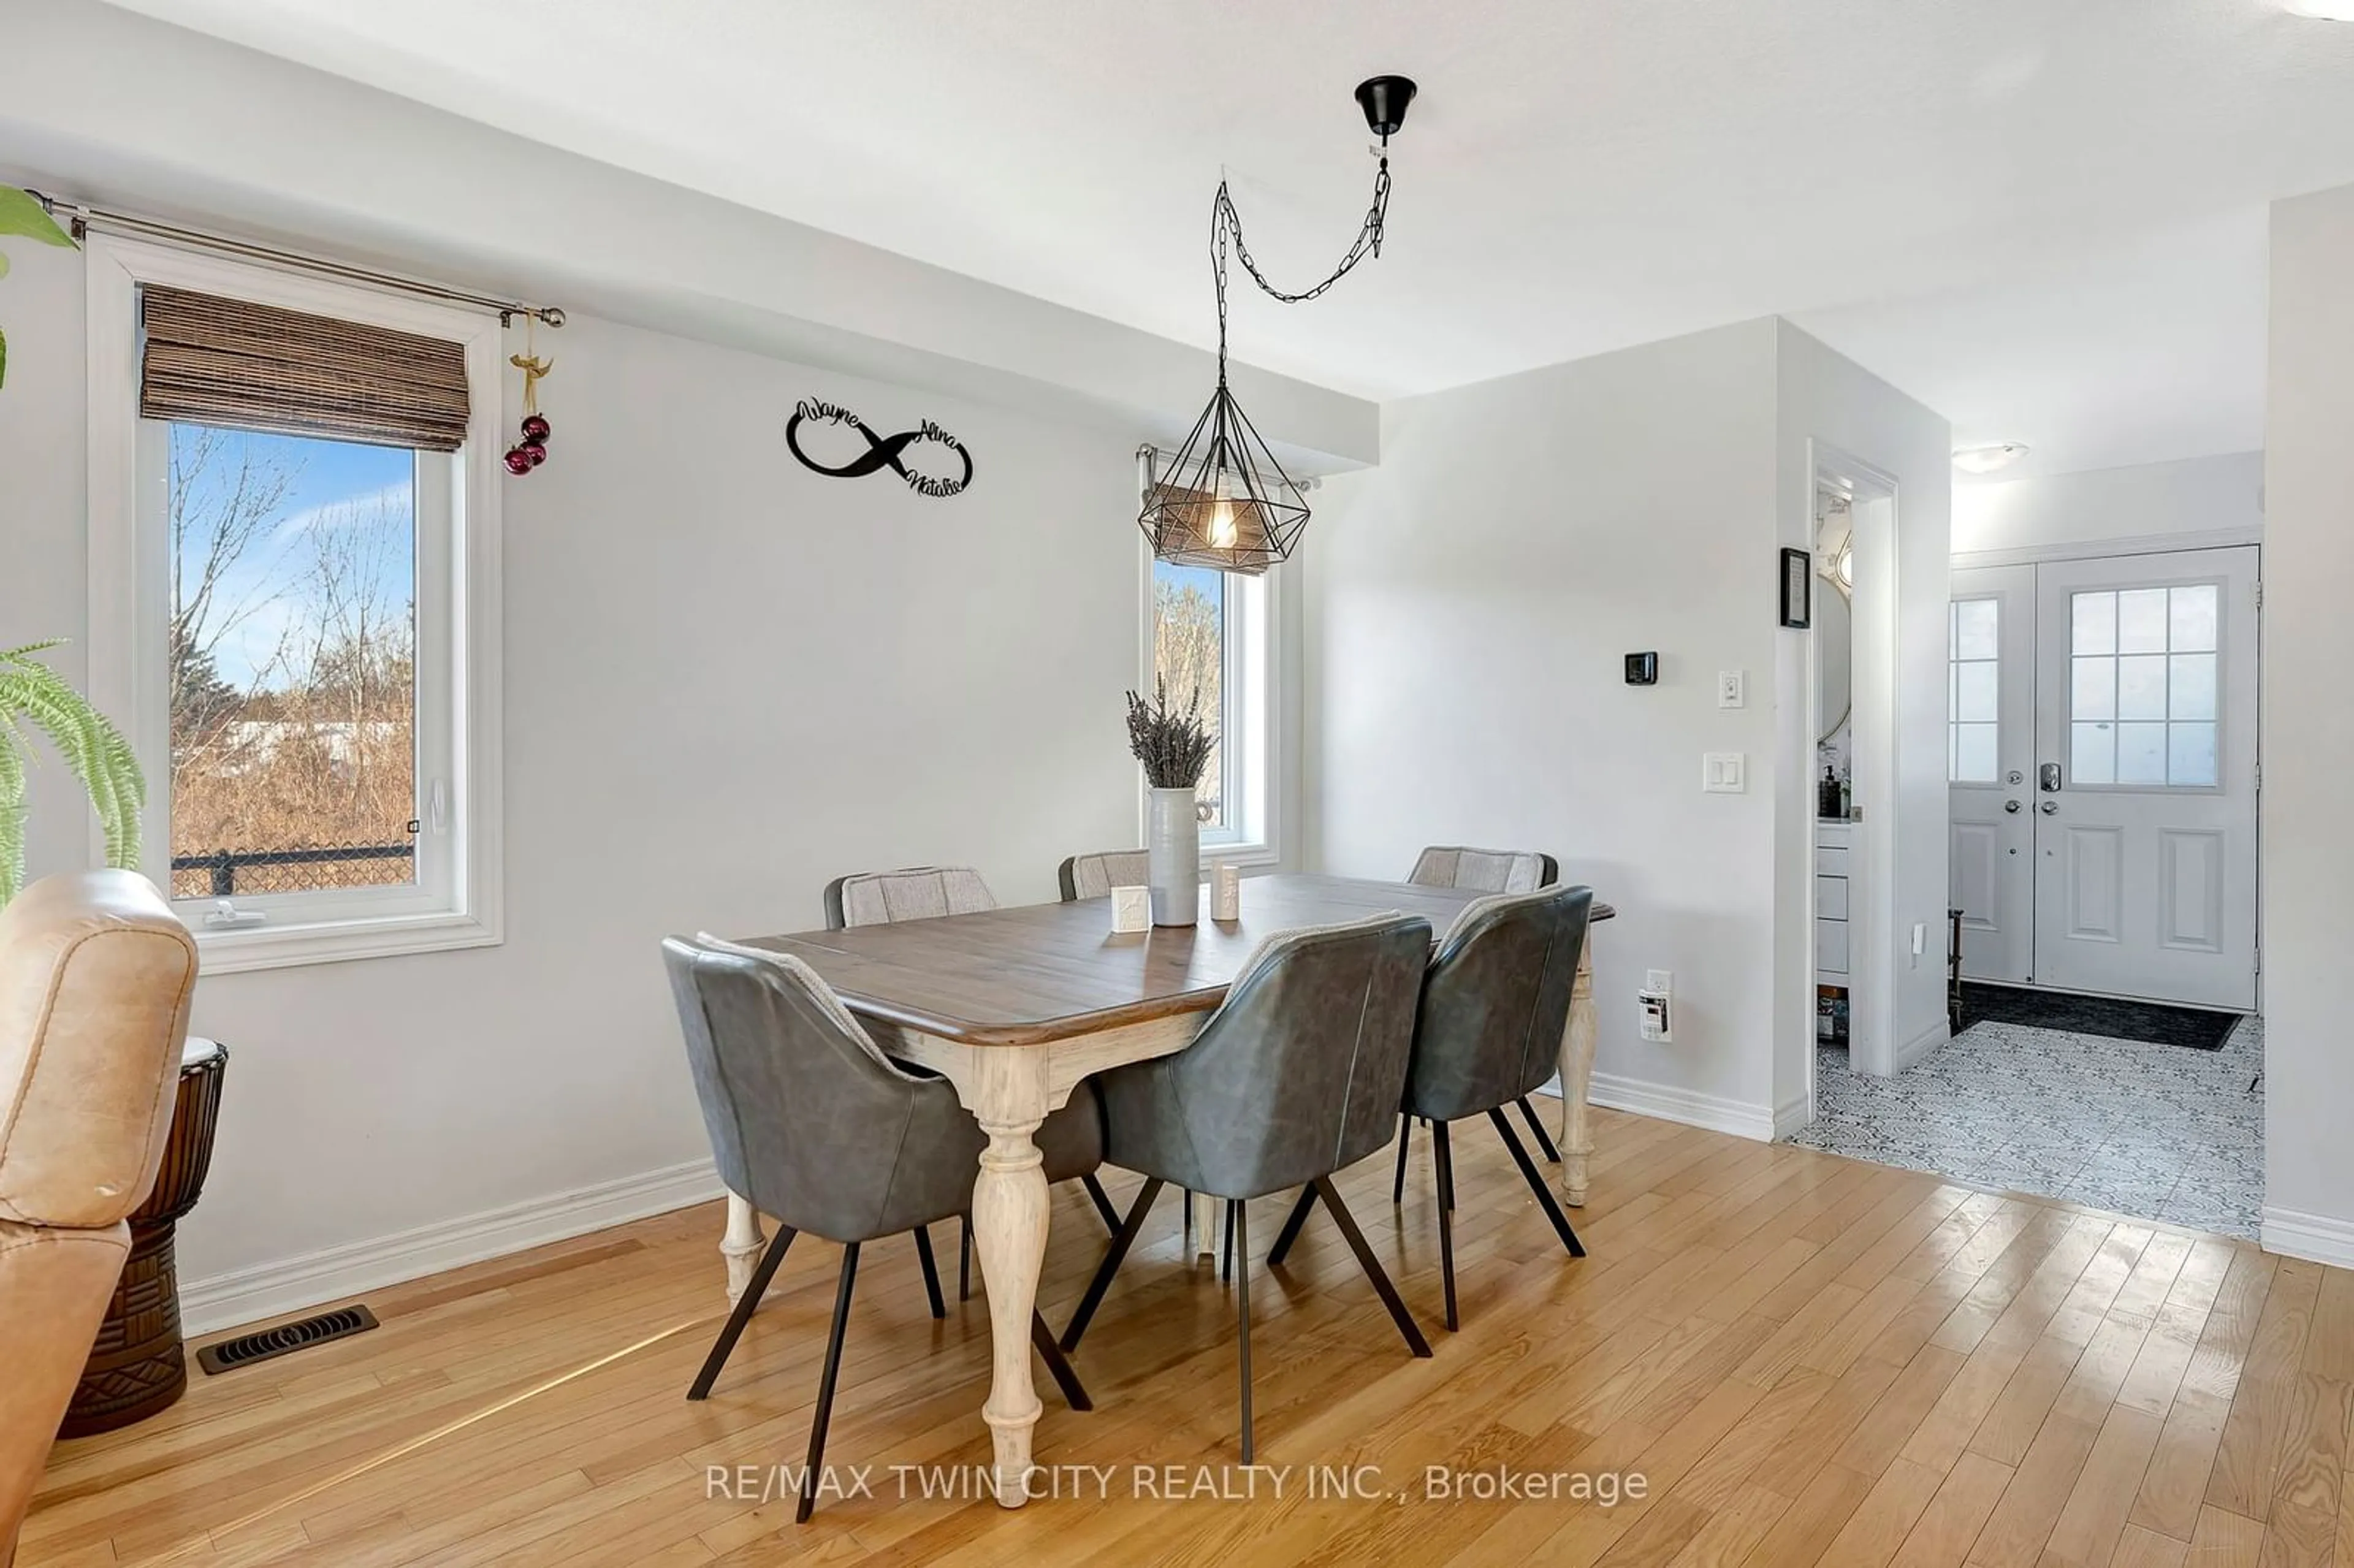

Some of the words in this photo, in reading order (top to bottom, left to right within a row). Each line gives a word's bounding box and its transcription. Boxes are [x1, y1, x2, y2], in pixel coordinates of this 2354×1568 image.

[796, 397, 859, 427] Wayne
[912, 418, 957, 449] Alina
[906, 470, 962, 498] Natalie
